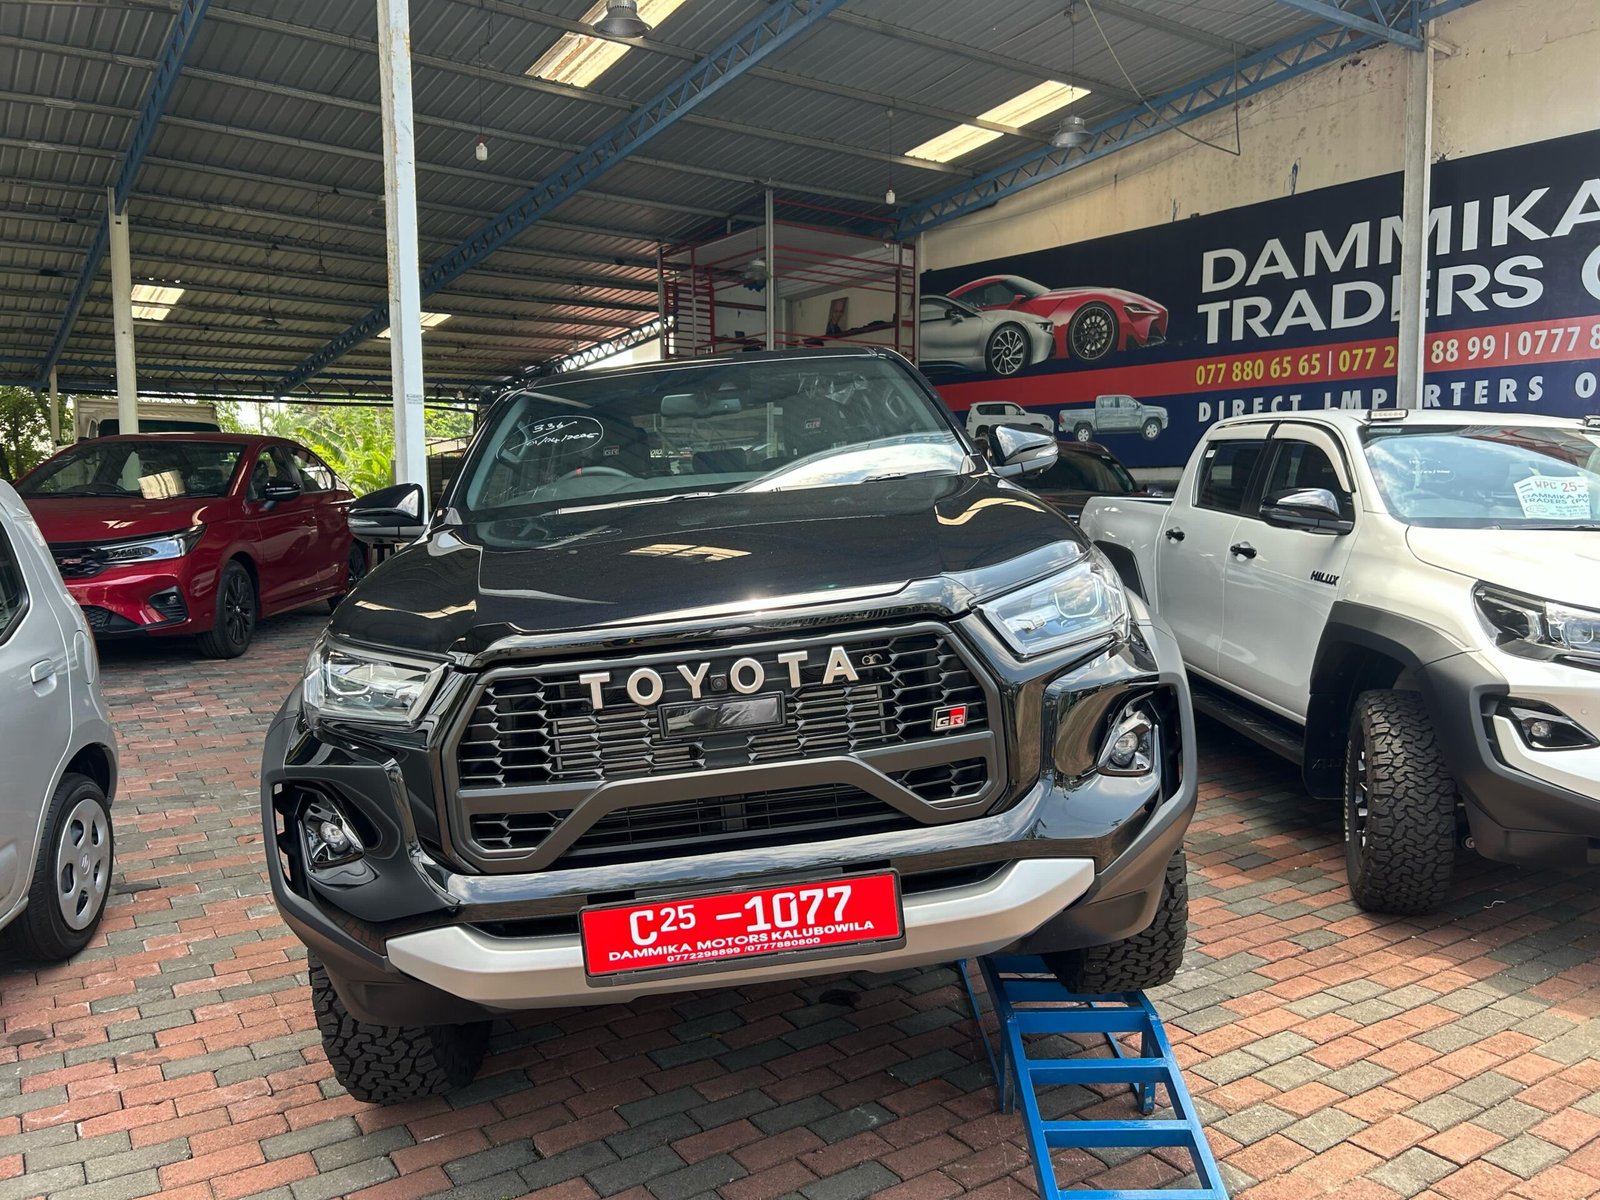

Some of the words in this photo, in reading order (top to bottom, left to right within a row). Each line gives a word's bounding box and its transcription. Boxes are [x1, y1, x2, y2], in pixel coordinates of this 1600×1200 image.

[1202, 178, 1600, 294] DAMMIKA
[1195, 363, 1226, 385] 077
[1232, 359, 1264, 382] 880
[1270, 355, 1292, 378] 65
[1298, 353, 1321, 376] 65
[1338, 347, 1376, 372] 077
[1431, 339, 1459, 364] 88
[1467, 335, 1496, 361] 99
[1517, 326, 1581, 356] 0777
[1198, 394, 1302, 423] DIRECT
[1324, 375, 1543, 410] IMPRTERS
[1310, 570, 1340, 586] HILUX
[579, 645, 860, 710] TOYOTA
[608, 943, 692, 961] DAMMIKA
[697, 932, 768, 950] MOTORS
[771, 920, 875, 941] KALUBOWILA
[666, 946, 740, 962] 0772298899
